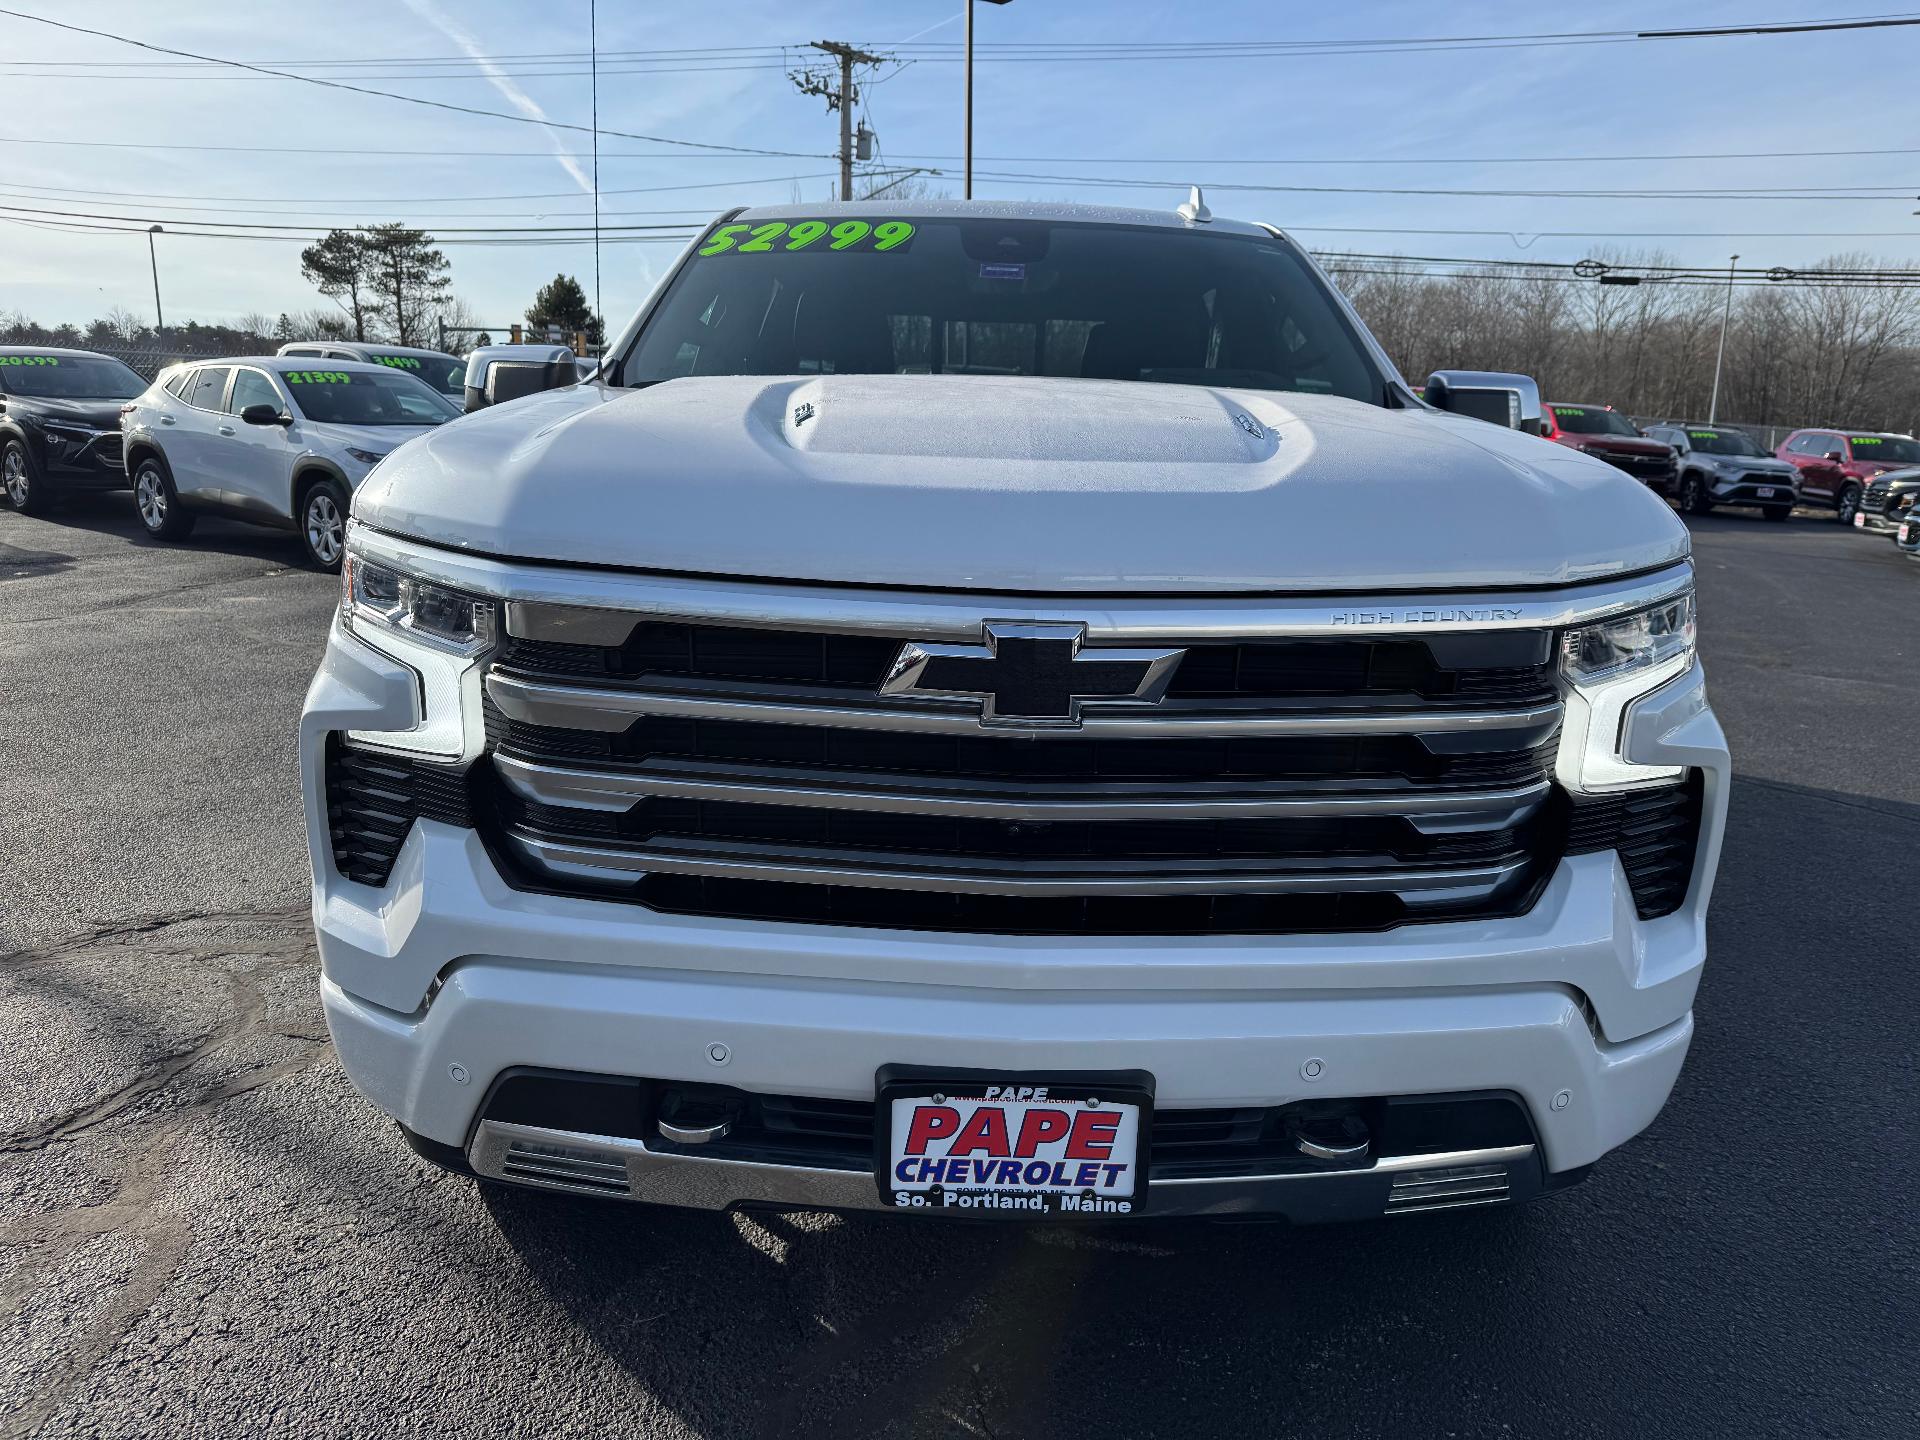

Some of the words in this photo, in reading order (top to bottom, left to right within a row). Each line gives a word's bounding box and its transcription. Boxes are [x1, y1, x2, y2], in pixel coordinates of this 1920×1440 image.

[698, 220, 917, 257] 52999
[0, 356, 59, 366] 20699
[372, 355, 421, 369] 36499
[286, 371, 351, 384] 21399
[1330, 611, 1394, 625] HIGH
[1403, 607, 1523, 623] COUNTRY
[984, 1086, 1049, 1101] PAPE
[903, 1105, 1124, 1161] PAPE
[895, 1157, 1128, 1188] CHEVROLET
[895, 1191, 932, 1208] So.
[943, 1192, 1050, 1214] Portland,
[1060, 1195, 1132, 1214] Maine
